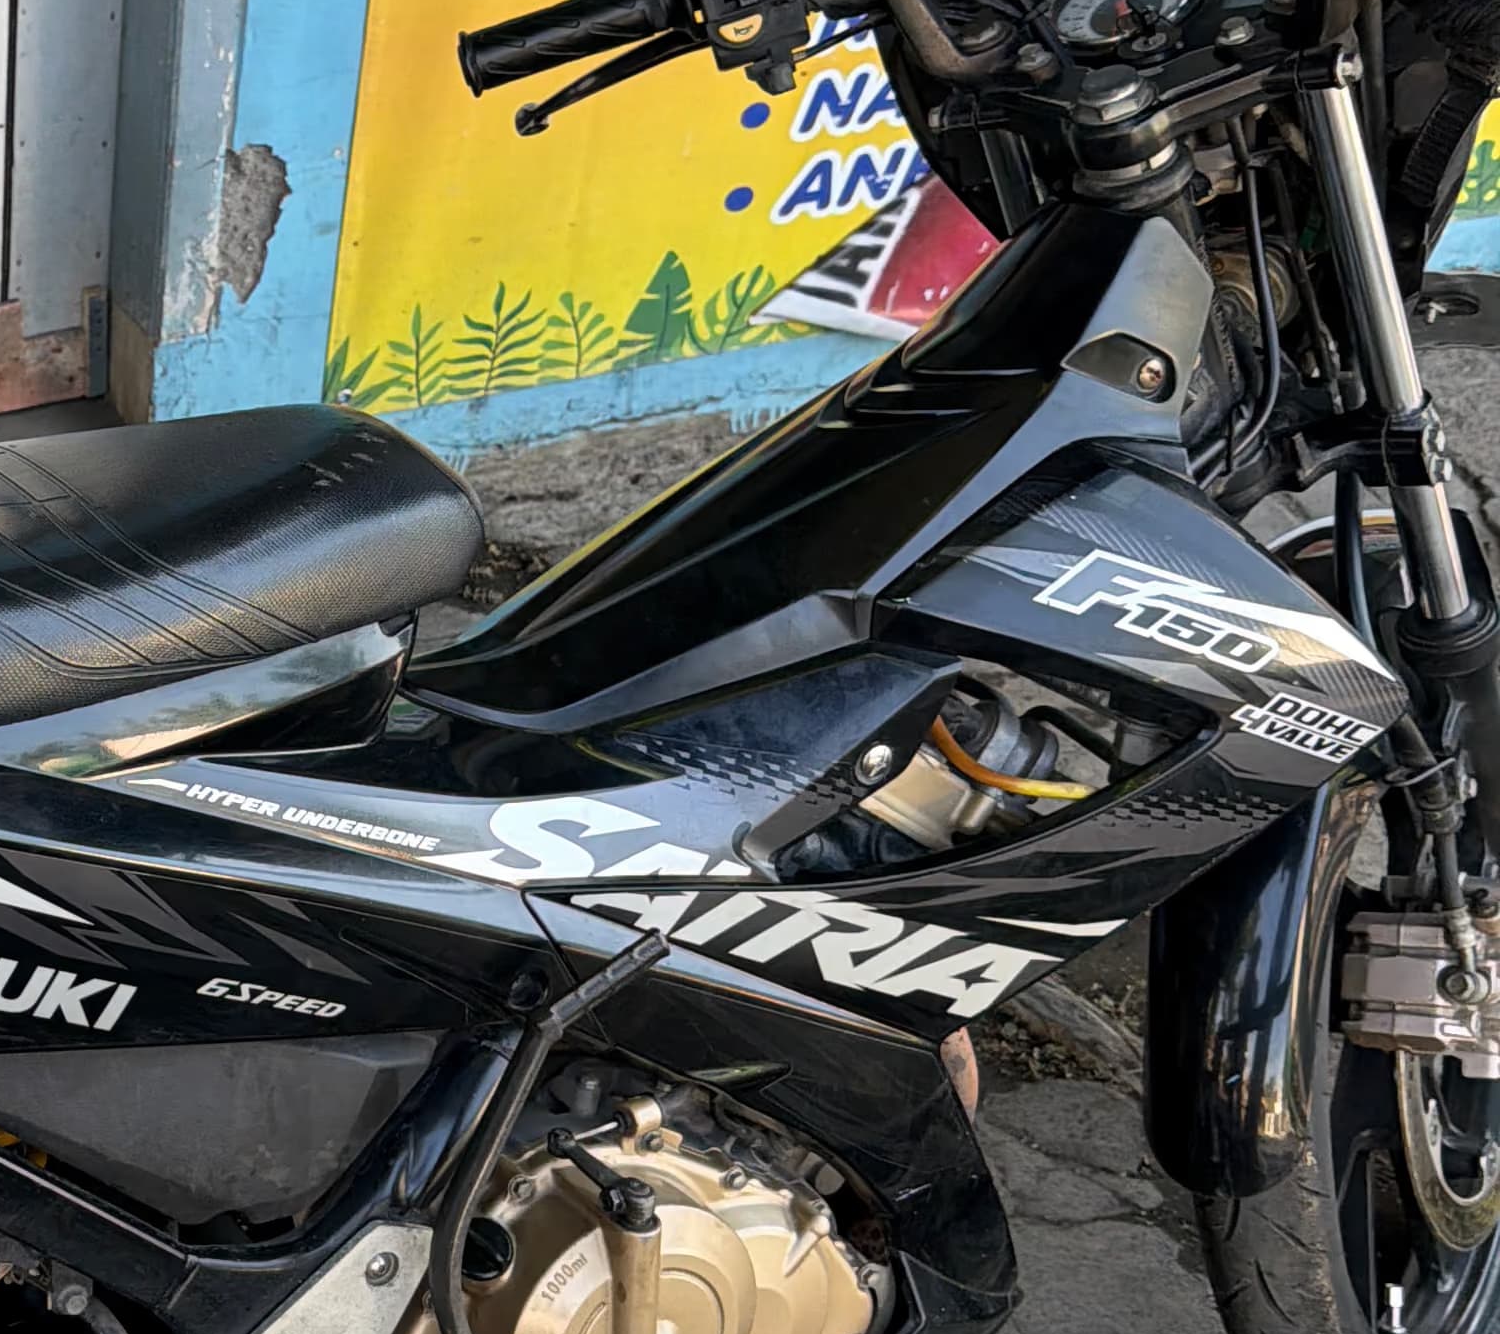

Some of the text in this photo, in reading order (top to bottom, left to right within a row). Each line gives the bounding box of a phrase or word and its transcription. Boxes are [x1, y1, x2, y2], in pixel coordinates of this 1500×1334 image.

[1033, 549, 1280, 673] F150
[1268, 697, 1379, 743] DOHC
[186, 784, 441, 852] HYPER UNDERBONE
[412, 796, 1066, 1019] SATRIA
